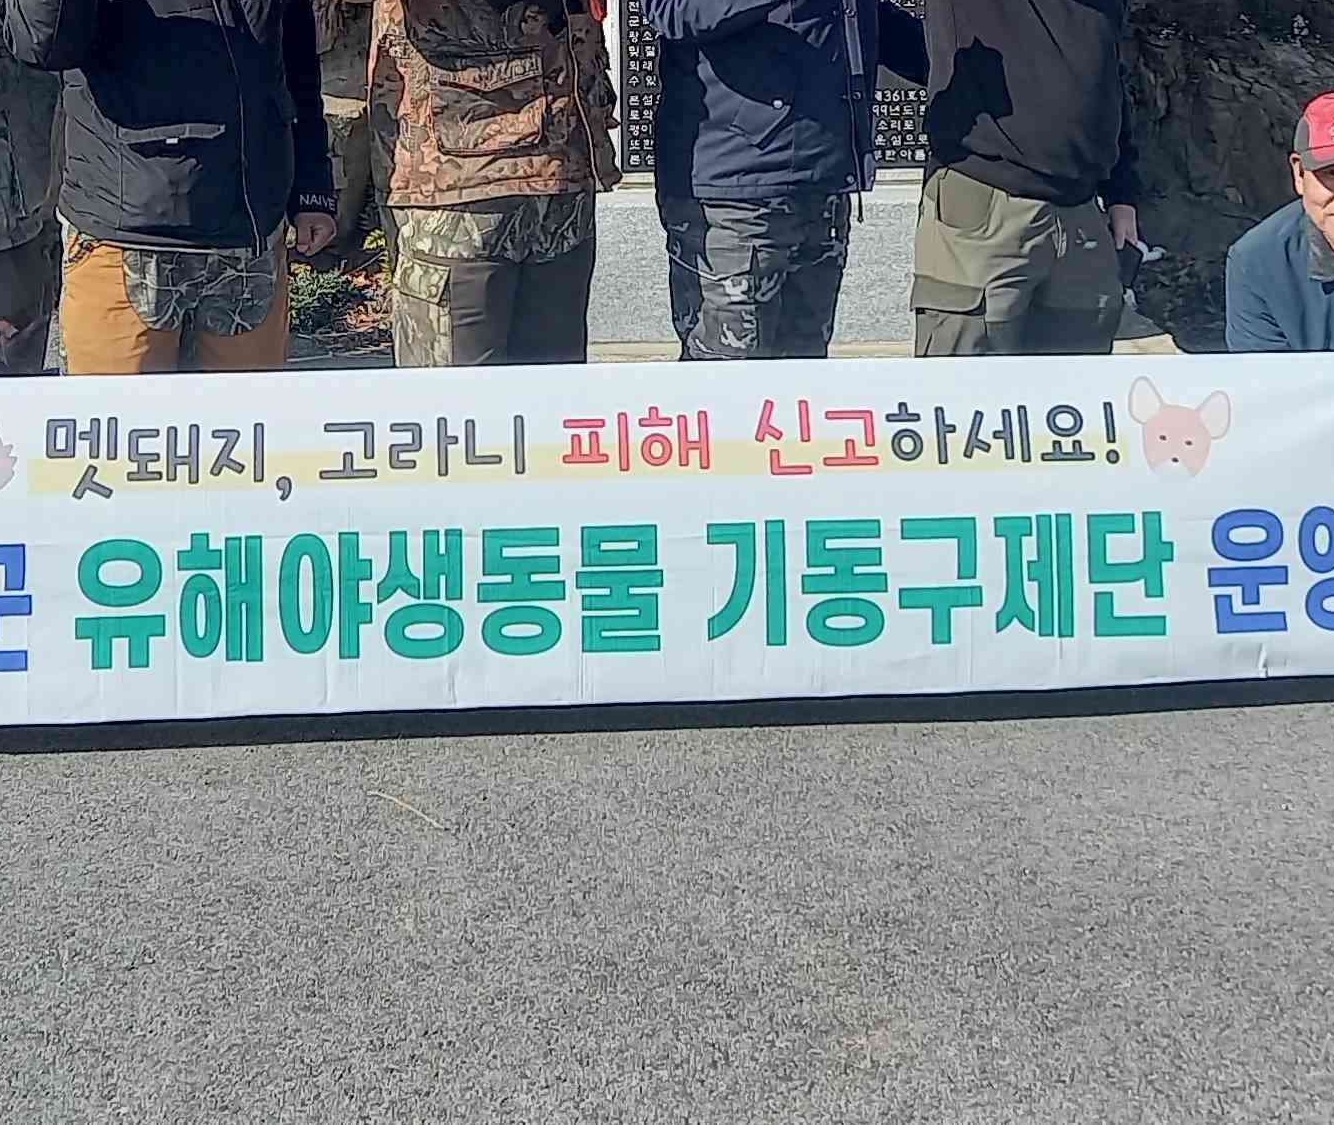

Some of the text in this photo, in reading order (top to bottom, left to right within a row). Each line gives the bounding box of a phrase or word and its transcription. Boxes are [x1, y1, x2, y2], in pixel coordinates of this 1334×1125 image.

[45, 397, 1121, 502] 멧돼지, 고라니 피해 신고하세요!
[73, 523, 665, 671] 유해야생동물
[705, 510, 1175, 648] 기동구제단
